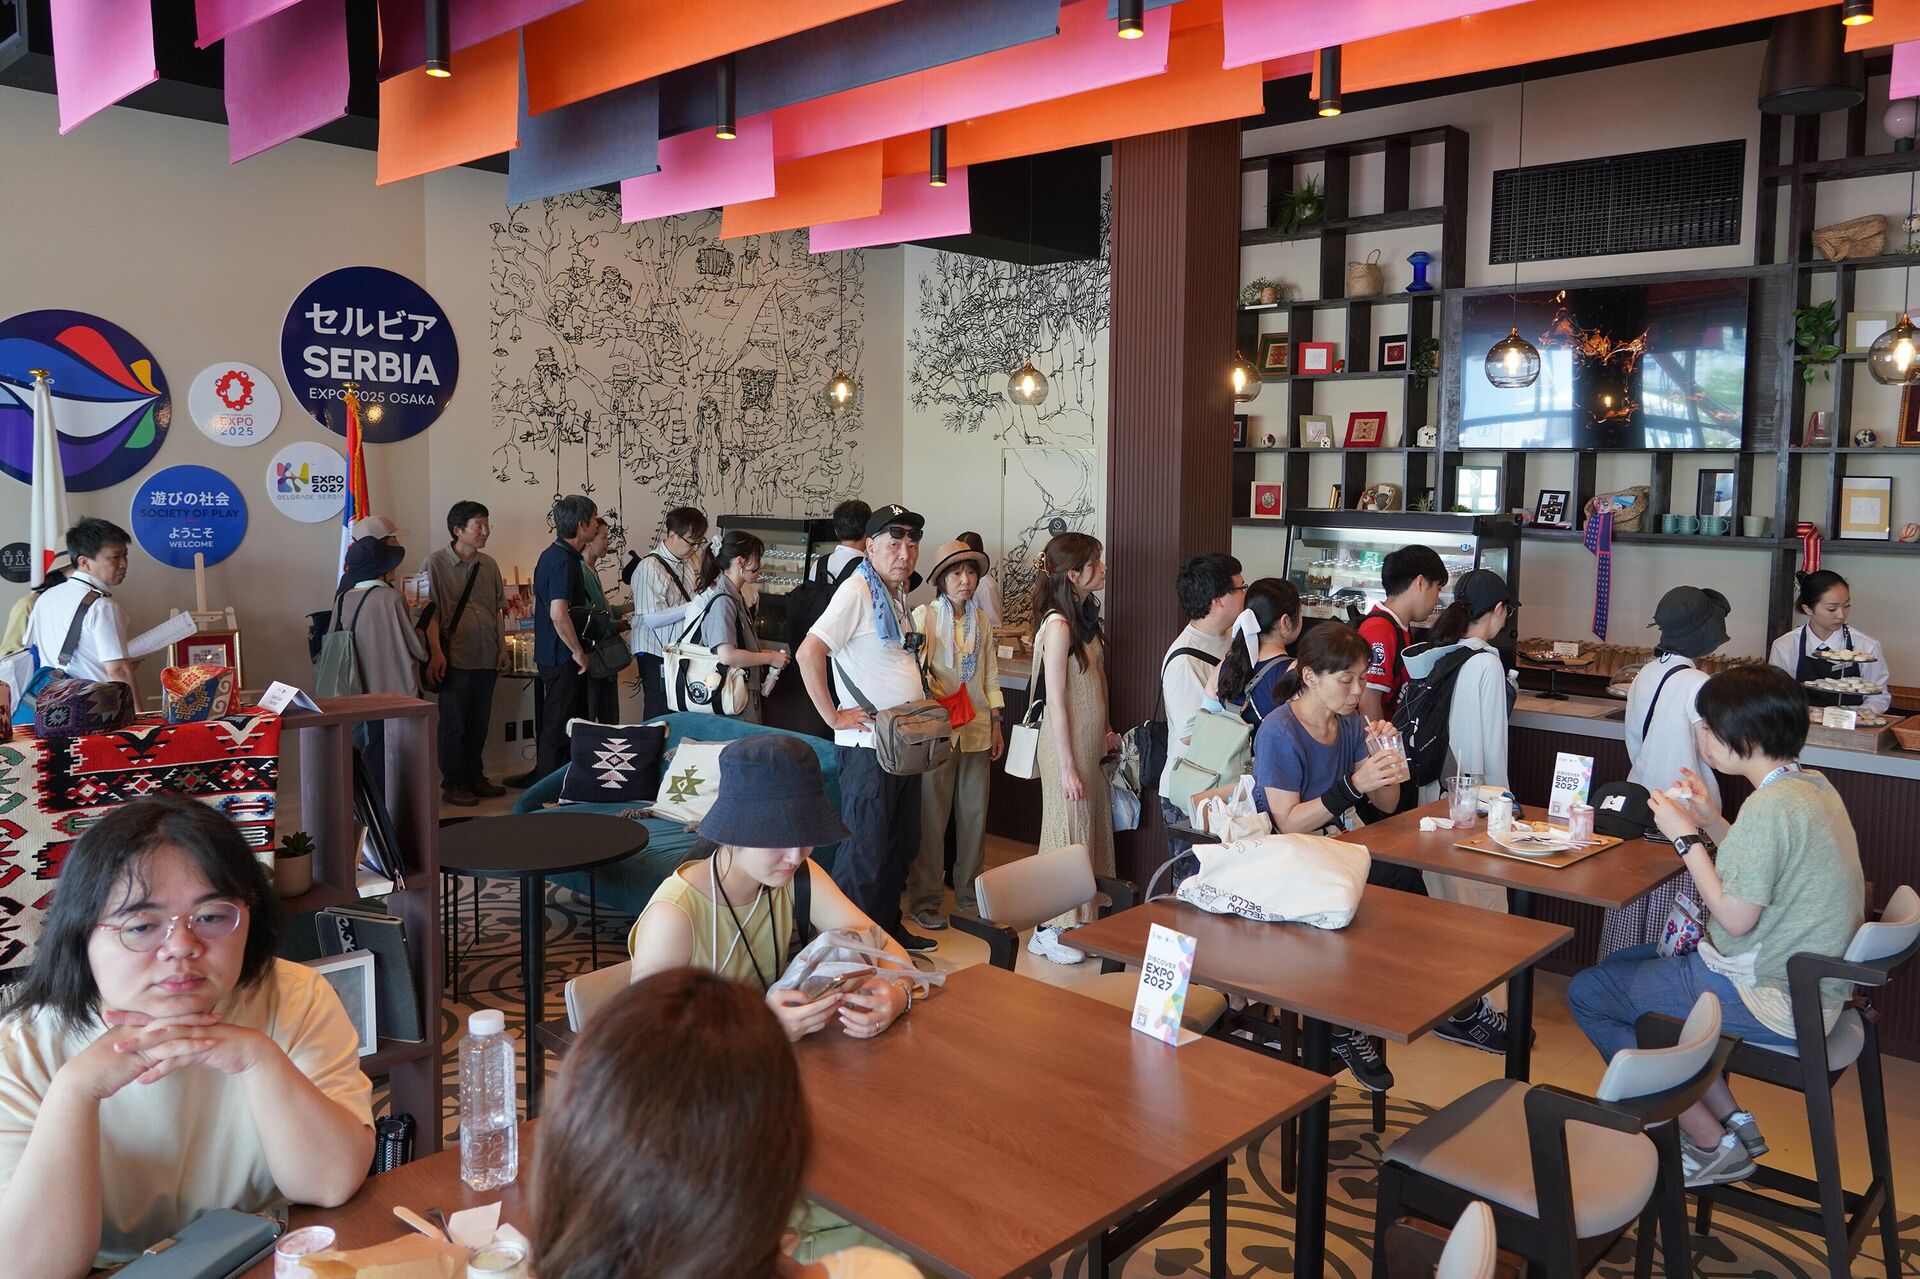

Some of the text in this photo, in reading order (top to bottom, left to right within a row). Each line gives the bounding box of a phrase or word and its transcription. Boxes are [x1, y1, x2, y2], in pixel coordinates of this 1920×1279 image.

[305, 303, 438, 342] セルビア
[303, 345, 440, 385] SERBIA
[309, 388, 436, 405] EXPO 2025 OSAKA
[220, 417, 254, 427] EXPO
[221, 427, 254, 436] 2025
[311, 475, 344, 484] EXPO
[312, 484, 344, 493] 2027
[150, 491, 230, 506] 遊びの社会
[140, 508, 240, 518] SOCIETY OF PLAY
[168, 527, 214, 539] ようこそ
[1555, 775, 1579, 784] EXPO
[1555, 782, 1578, 791] 2027
[1147, 954, 1177, 969] DISCOVER
[1145, 962, 1175, 981] EXPO
[1143, 973, 1173, 991] 2027
